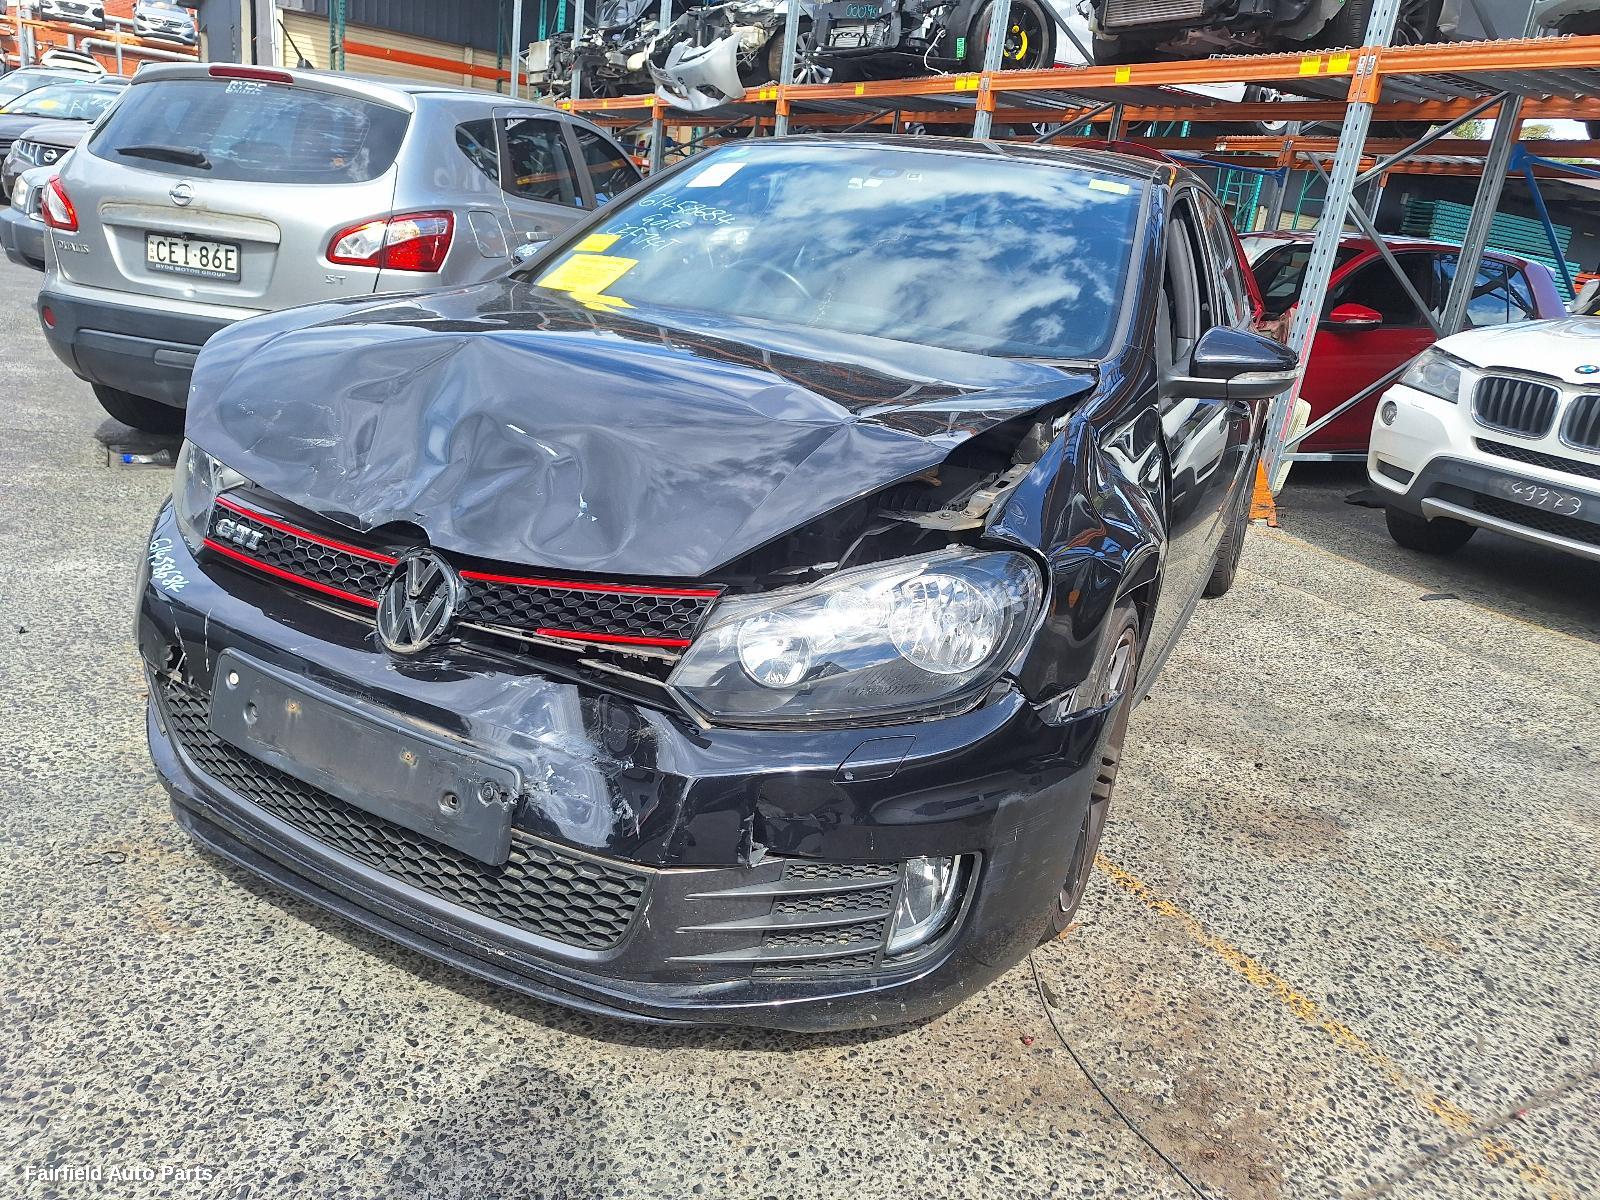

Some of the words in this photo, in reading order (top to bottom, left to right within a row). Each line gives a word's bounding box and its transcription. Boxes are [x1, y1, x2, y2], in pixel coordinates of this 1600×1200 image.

[155, 263, 174, 271] RYDE
[175, 266, 200, 275] MOTOR
[215, 518, 264, 551] GTI
